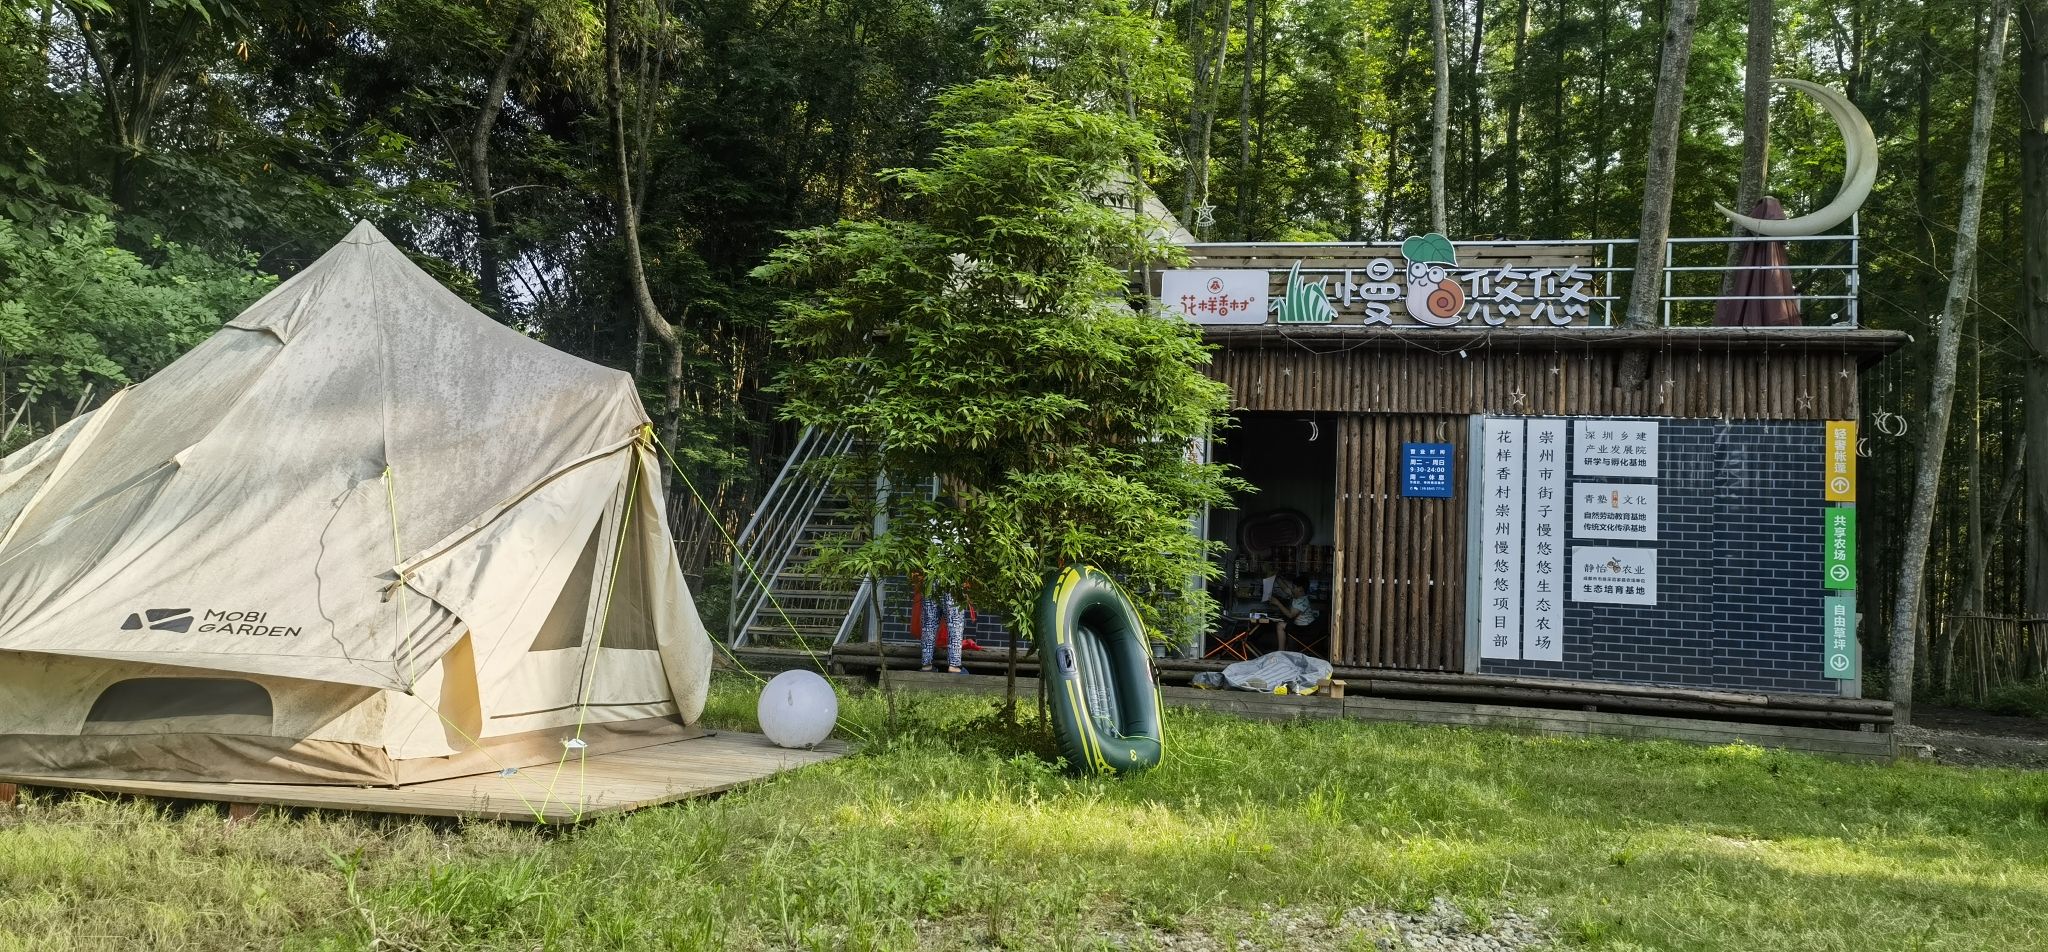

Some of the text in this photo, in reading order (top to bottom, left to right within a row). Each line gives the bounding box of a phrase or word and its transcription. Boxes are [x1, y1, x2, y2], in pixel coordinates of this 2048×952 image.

[1180, 294, 1249, 316] 花样香村
[1585, 431, 1647, 441] 深圳乡建
[1585, 444, 1647, 455] 产业发展院
[1584, 457, 1647, 467] 研学与孵化基地
[1584, 511, 1647, 521] 自然劳动教育基地
[1584, 523, 1647, 533] 传统文化传承基地
[1492, 430, 1512, 648] 花样香村崇州慢悠悠项目部
[1535, 431, 1555, 650] 崇州市街子慢悠悠生态农场
[1834, 515, 1847, 561] 共享农场
[1583, 584, 1646, 595] 生态培育基地
[203, 608, 267, 624] MOBI
[198, 623, 303, 637] GARDEN
[1833, 604, 1847, 651] 自由草坪
